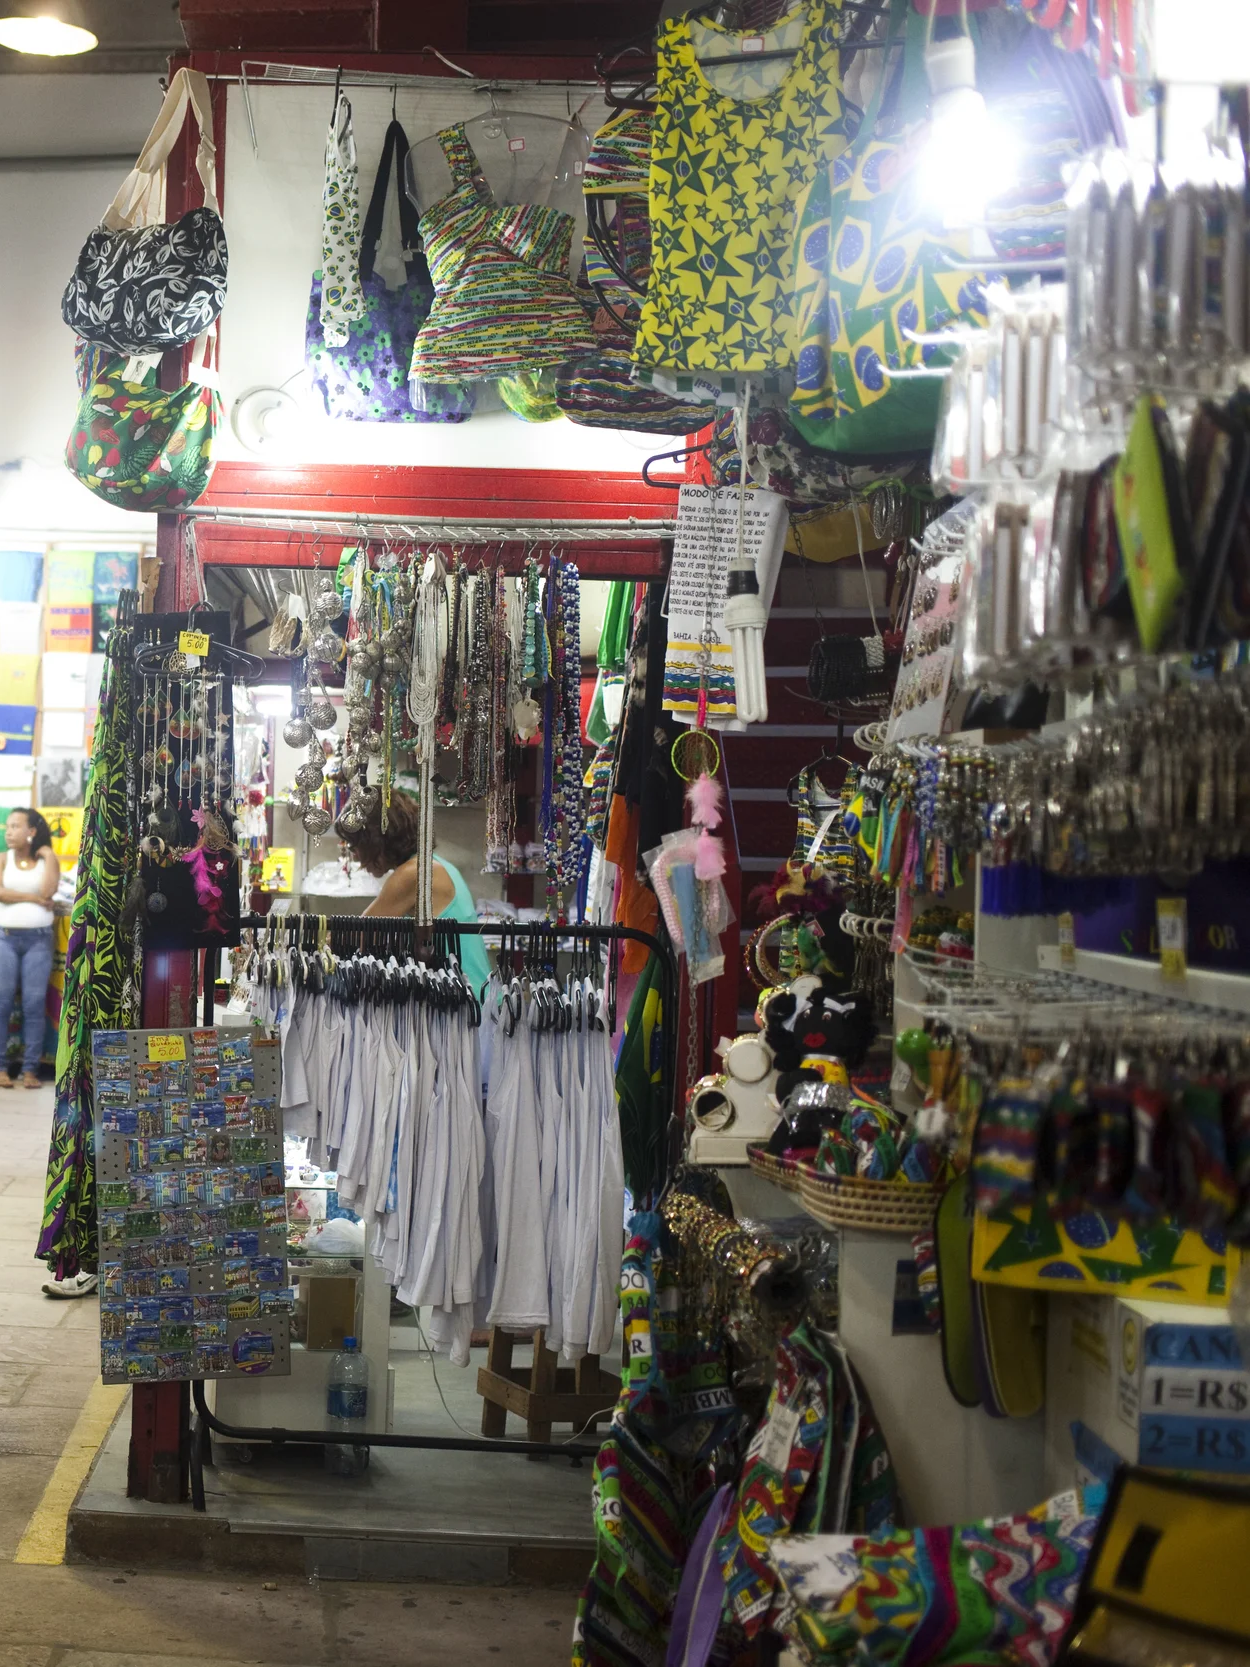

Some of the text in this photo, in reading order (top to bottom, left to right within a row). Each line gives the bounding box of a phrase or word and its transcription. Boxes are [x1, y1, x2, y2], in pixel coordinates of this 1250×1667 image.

[694, 377, 721, 399] Brasil
[684, 489, 755, 501] MODO DE FAZER
[673, 631, 692, 641] BAHIA
[158, 1047, 180, 1057] 5.00
